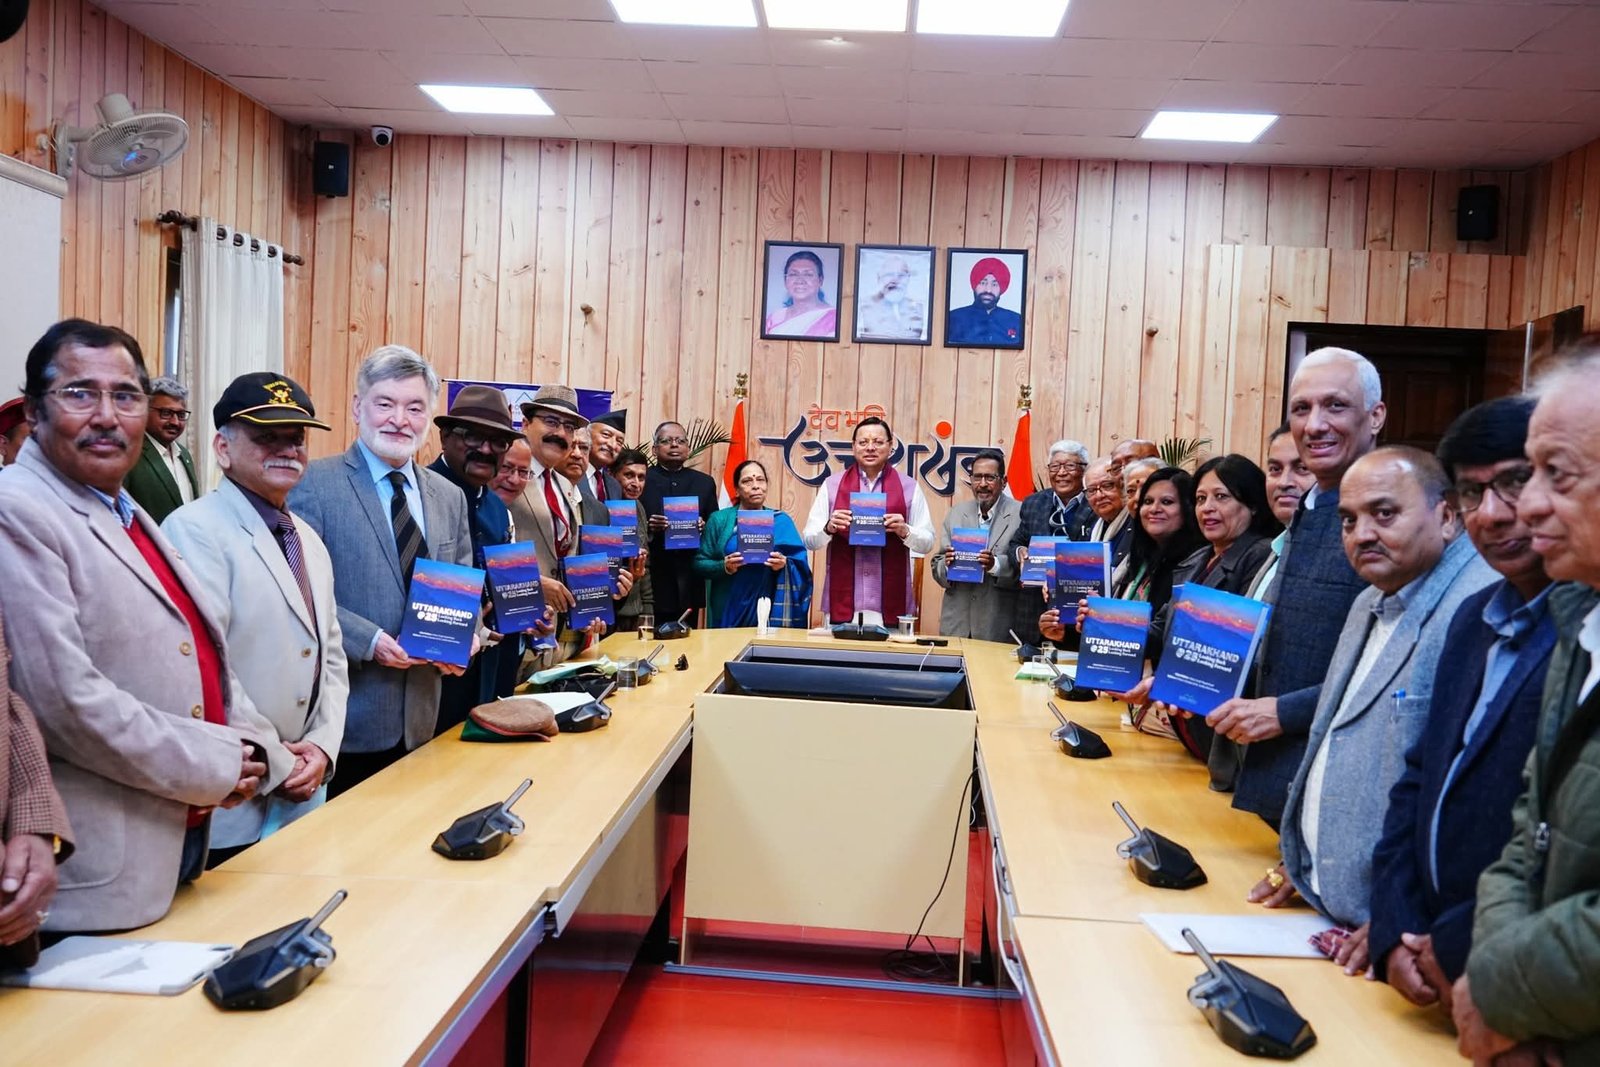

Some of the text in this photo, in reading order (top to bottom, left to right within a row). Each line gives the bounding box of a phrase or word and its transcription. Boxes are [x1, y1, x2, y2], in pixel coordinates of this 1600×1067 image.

[412, 602, 473, 619] UTTARAKHAND
[1085, 637, 1141, 650] UTTARAKHAND
[1090, 645, 1108, 654] @25
[1172, 636, 1240, 663] UTTARAKHAND
[1175, 647, 1198, 662] @25
